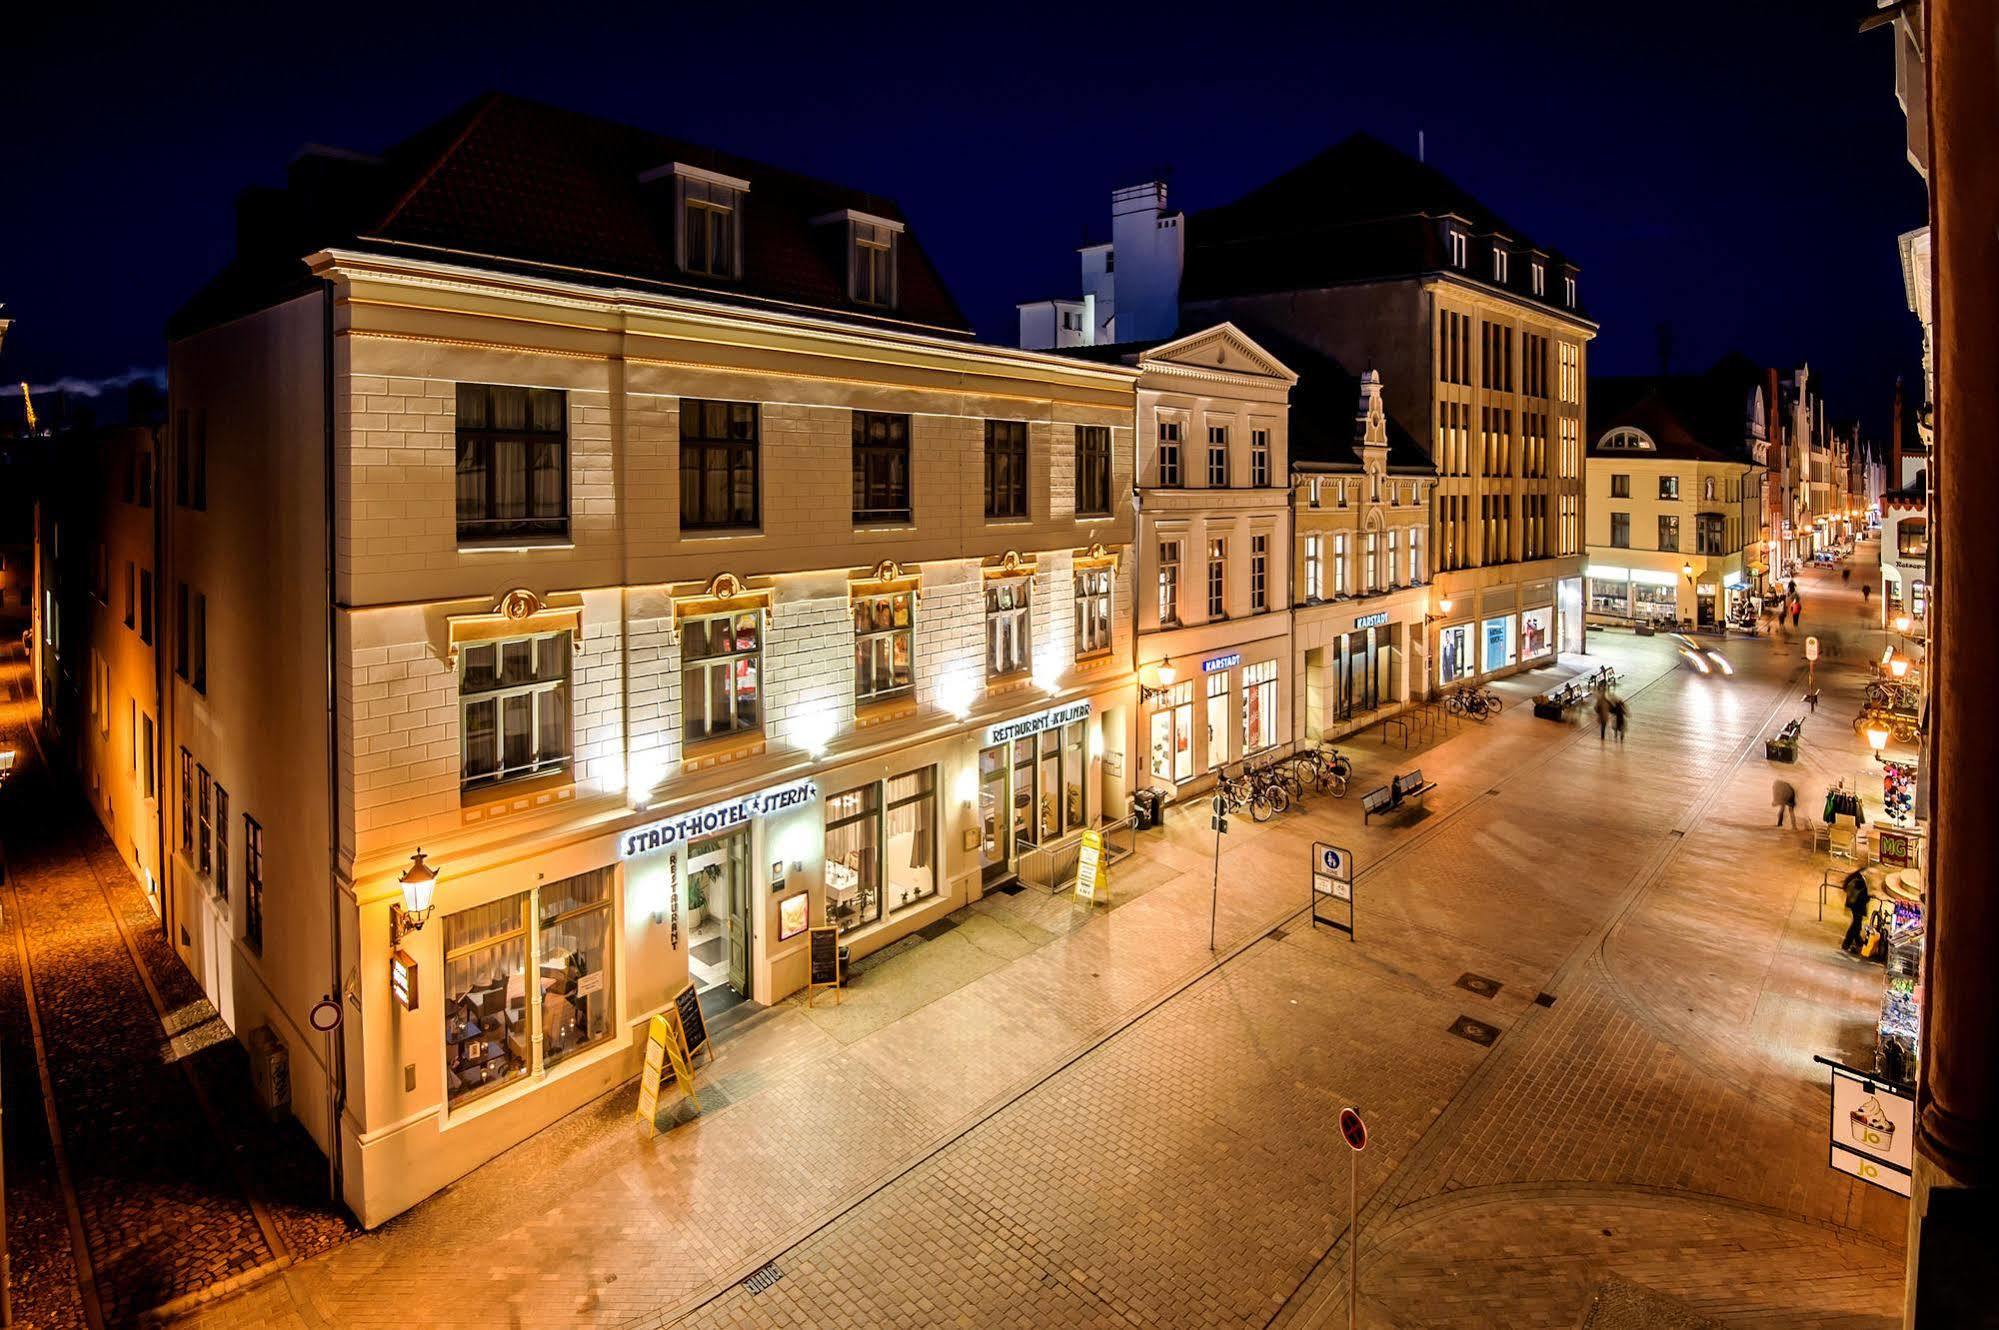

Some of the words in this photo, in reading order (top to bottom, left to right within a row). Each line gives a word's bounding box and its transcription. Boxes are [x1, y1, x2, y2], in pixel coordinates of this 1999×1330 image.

[1357, 612, 1388, 628] KARSTADT
[1206, 655, 1240, 671] KARSTADT
[992, 715, 1049, 743] RESTAURANT
[627, 804, 748, 855] STADT-HOTEL
[762, 785, 809, 813] STERN
[1881, 836, 1906, 857] MG
[670, 855, 678, 950] RESTAURANT
